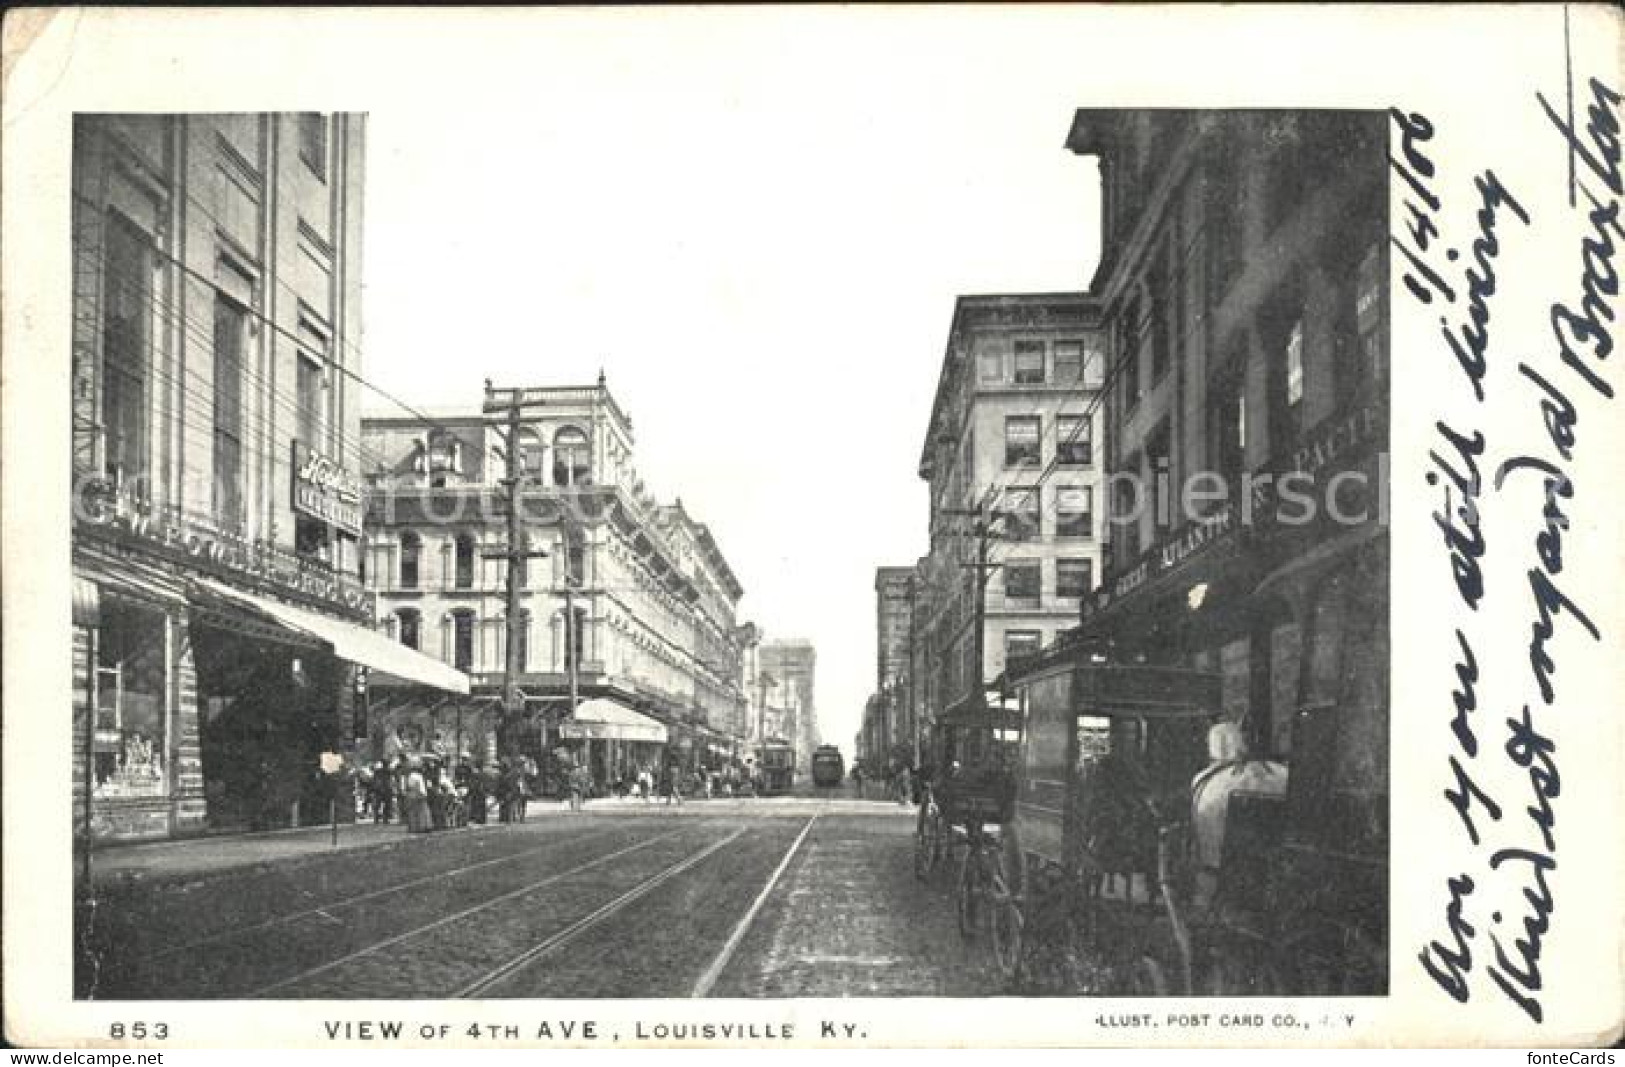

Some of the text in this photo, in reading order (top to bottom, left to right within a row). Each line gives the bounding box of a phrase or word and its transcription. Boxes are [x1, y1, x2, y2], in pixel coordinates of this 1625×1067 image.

[1426, 421, 1485, 610] still
[1444, 628, 1502, 845] you
[325, 1020, 403, 1040] VIEW
[1095, 1013, 1159, 1027] LLUST.
[1167, 1013, 1210, 1027] POST
[1219, 1013, 1264, 1027] CARD
[110, 1021, 169, 1041] 853
